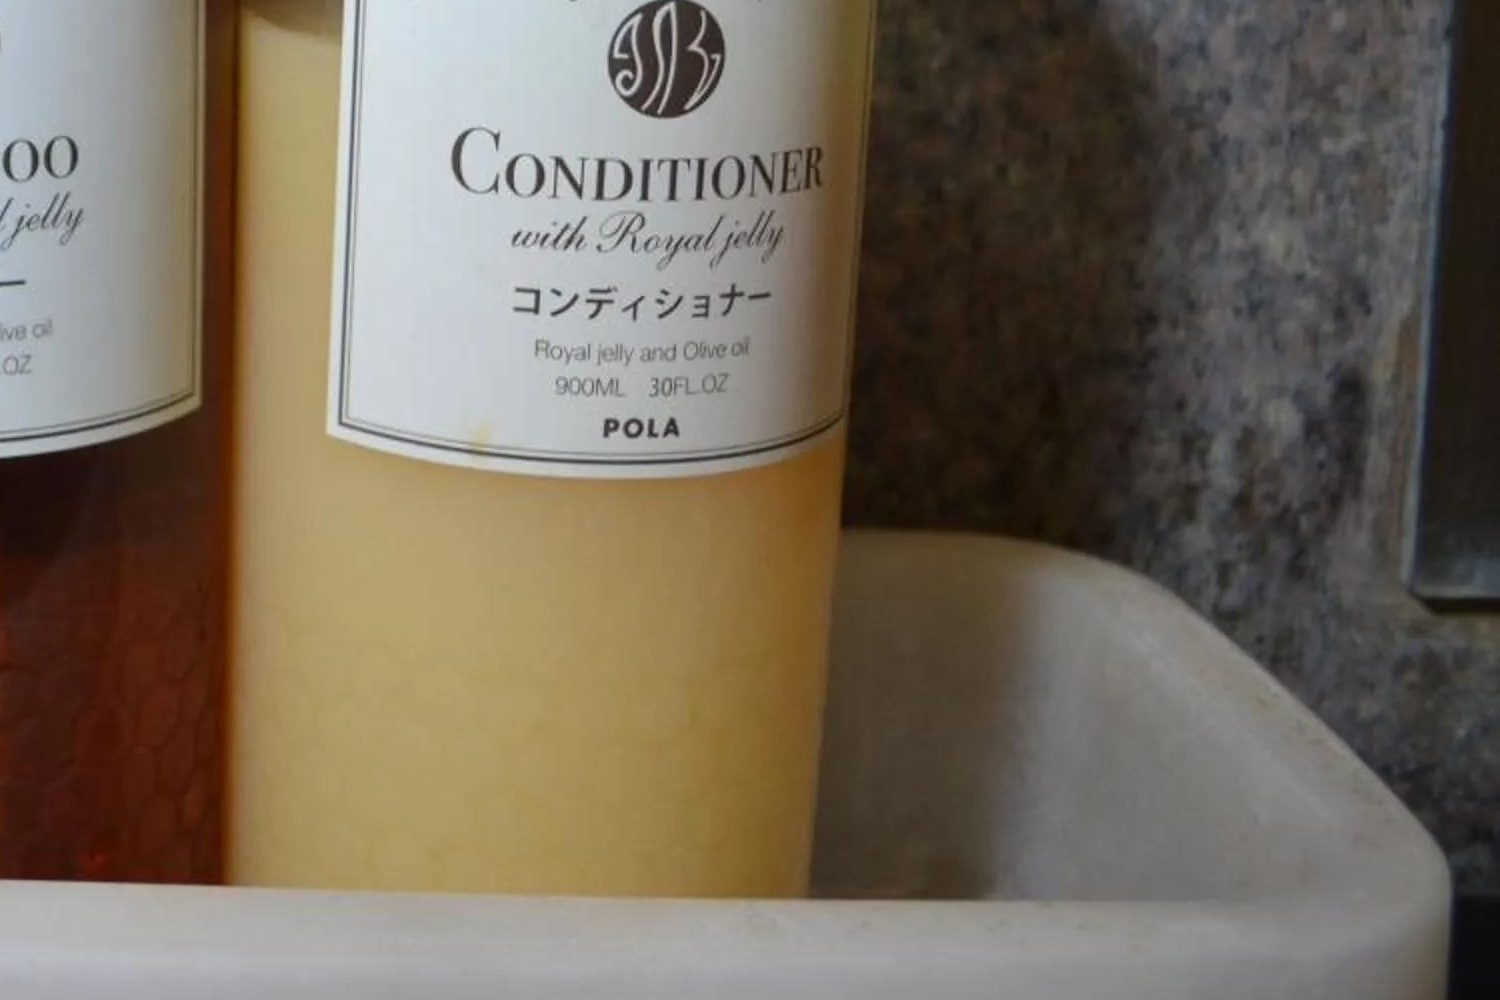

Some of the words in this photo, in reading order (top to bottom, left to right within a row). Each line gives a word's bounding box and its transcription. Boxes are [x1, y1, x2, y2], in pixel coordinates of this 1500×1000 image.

[450, 127, 824, 202] CONDITIONER
[4, 192, 85, 251] jelly
[511, 213, 587, 250] with
[597, 210, 721, 270] Royal
[711, 210, 784, 268] jelly
[512, 283, 771, 321] コンディショナー
[32, 319, 52, 339] oil
[534, 338, 591, 366] Royal
[597, 342, 634, 366] jelly
[640, 343, 677, 362] and
[683, 340, 727, 361] Olive
[731, 337, 751, 356] oil
[555, 376, 626, 398] 900ML
[603, 417, 680, 438] POLA
